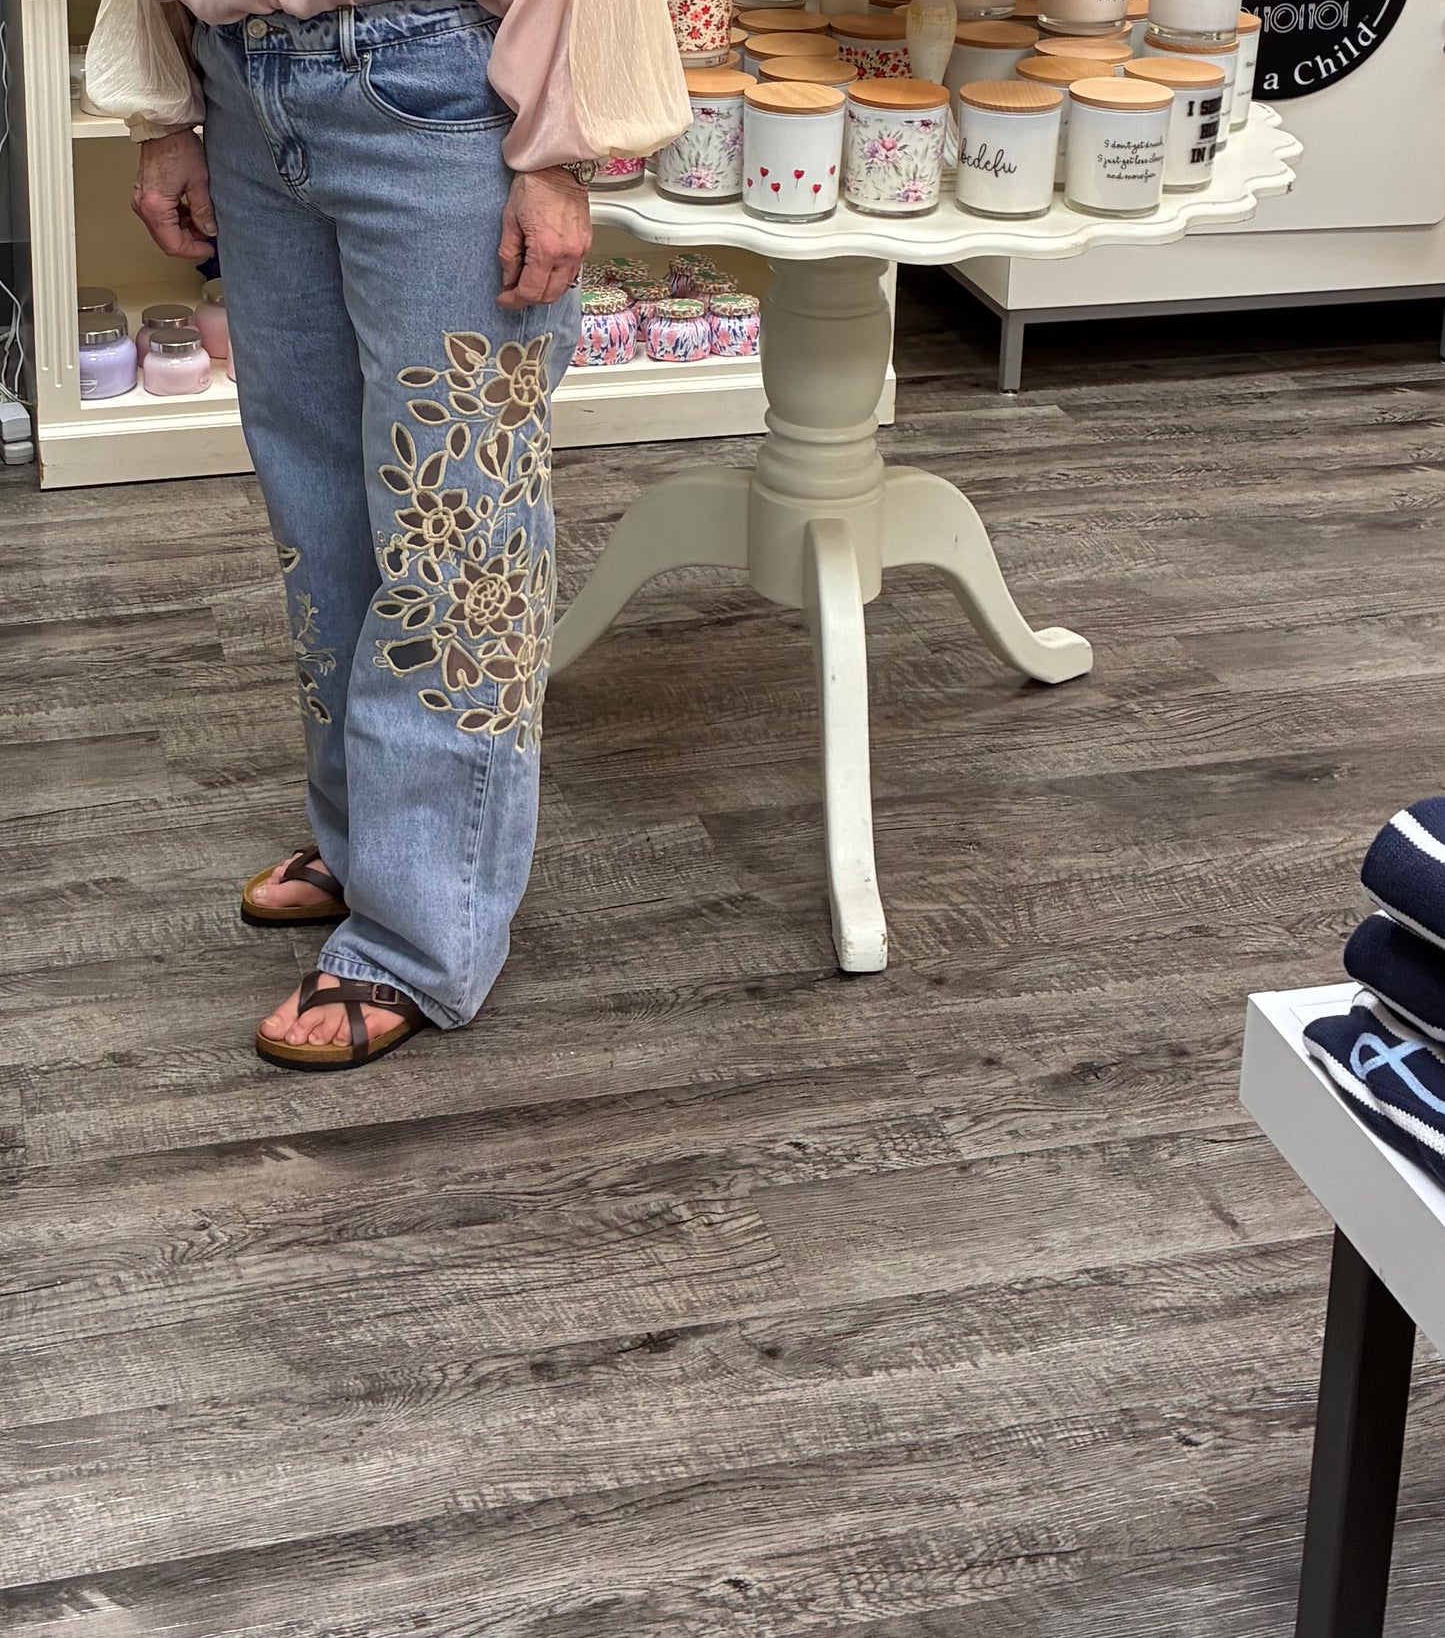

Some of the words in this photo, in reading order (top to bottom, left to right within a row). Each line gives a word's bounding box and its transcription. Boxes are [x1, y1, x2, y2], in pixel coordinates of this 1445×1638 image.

[1262, 72, 1279, 90] a
[1293, 23, 1378, 85] Child
[958, 137, 1018, 178] bcdefu
[1106, 172, 1123, 180] and
